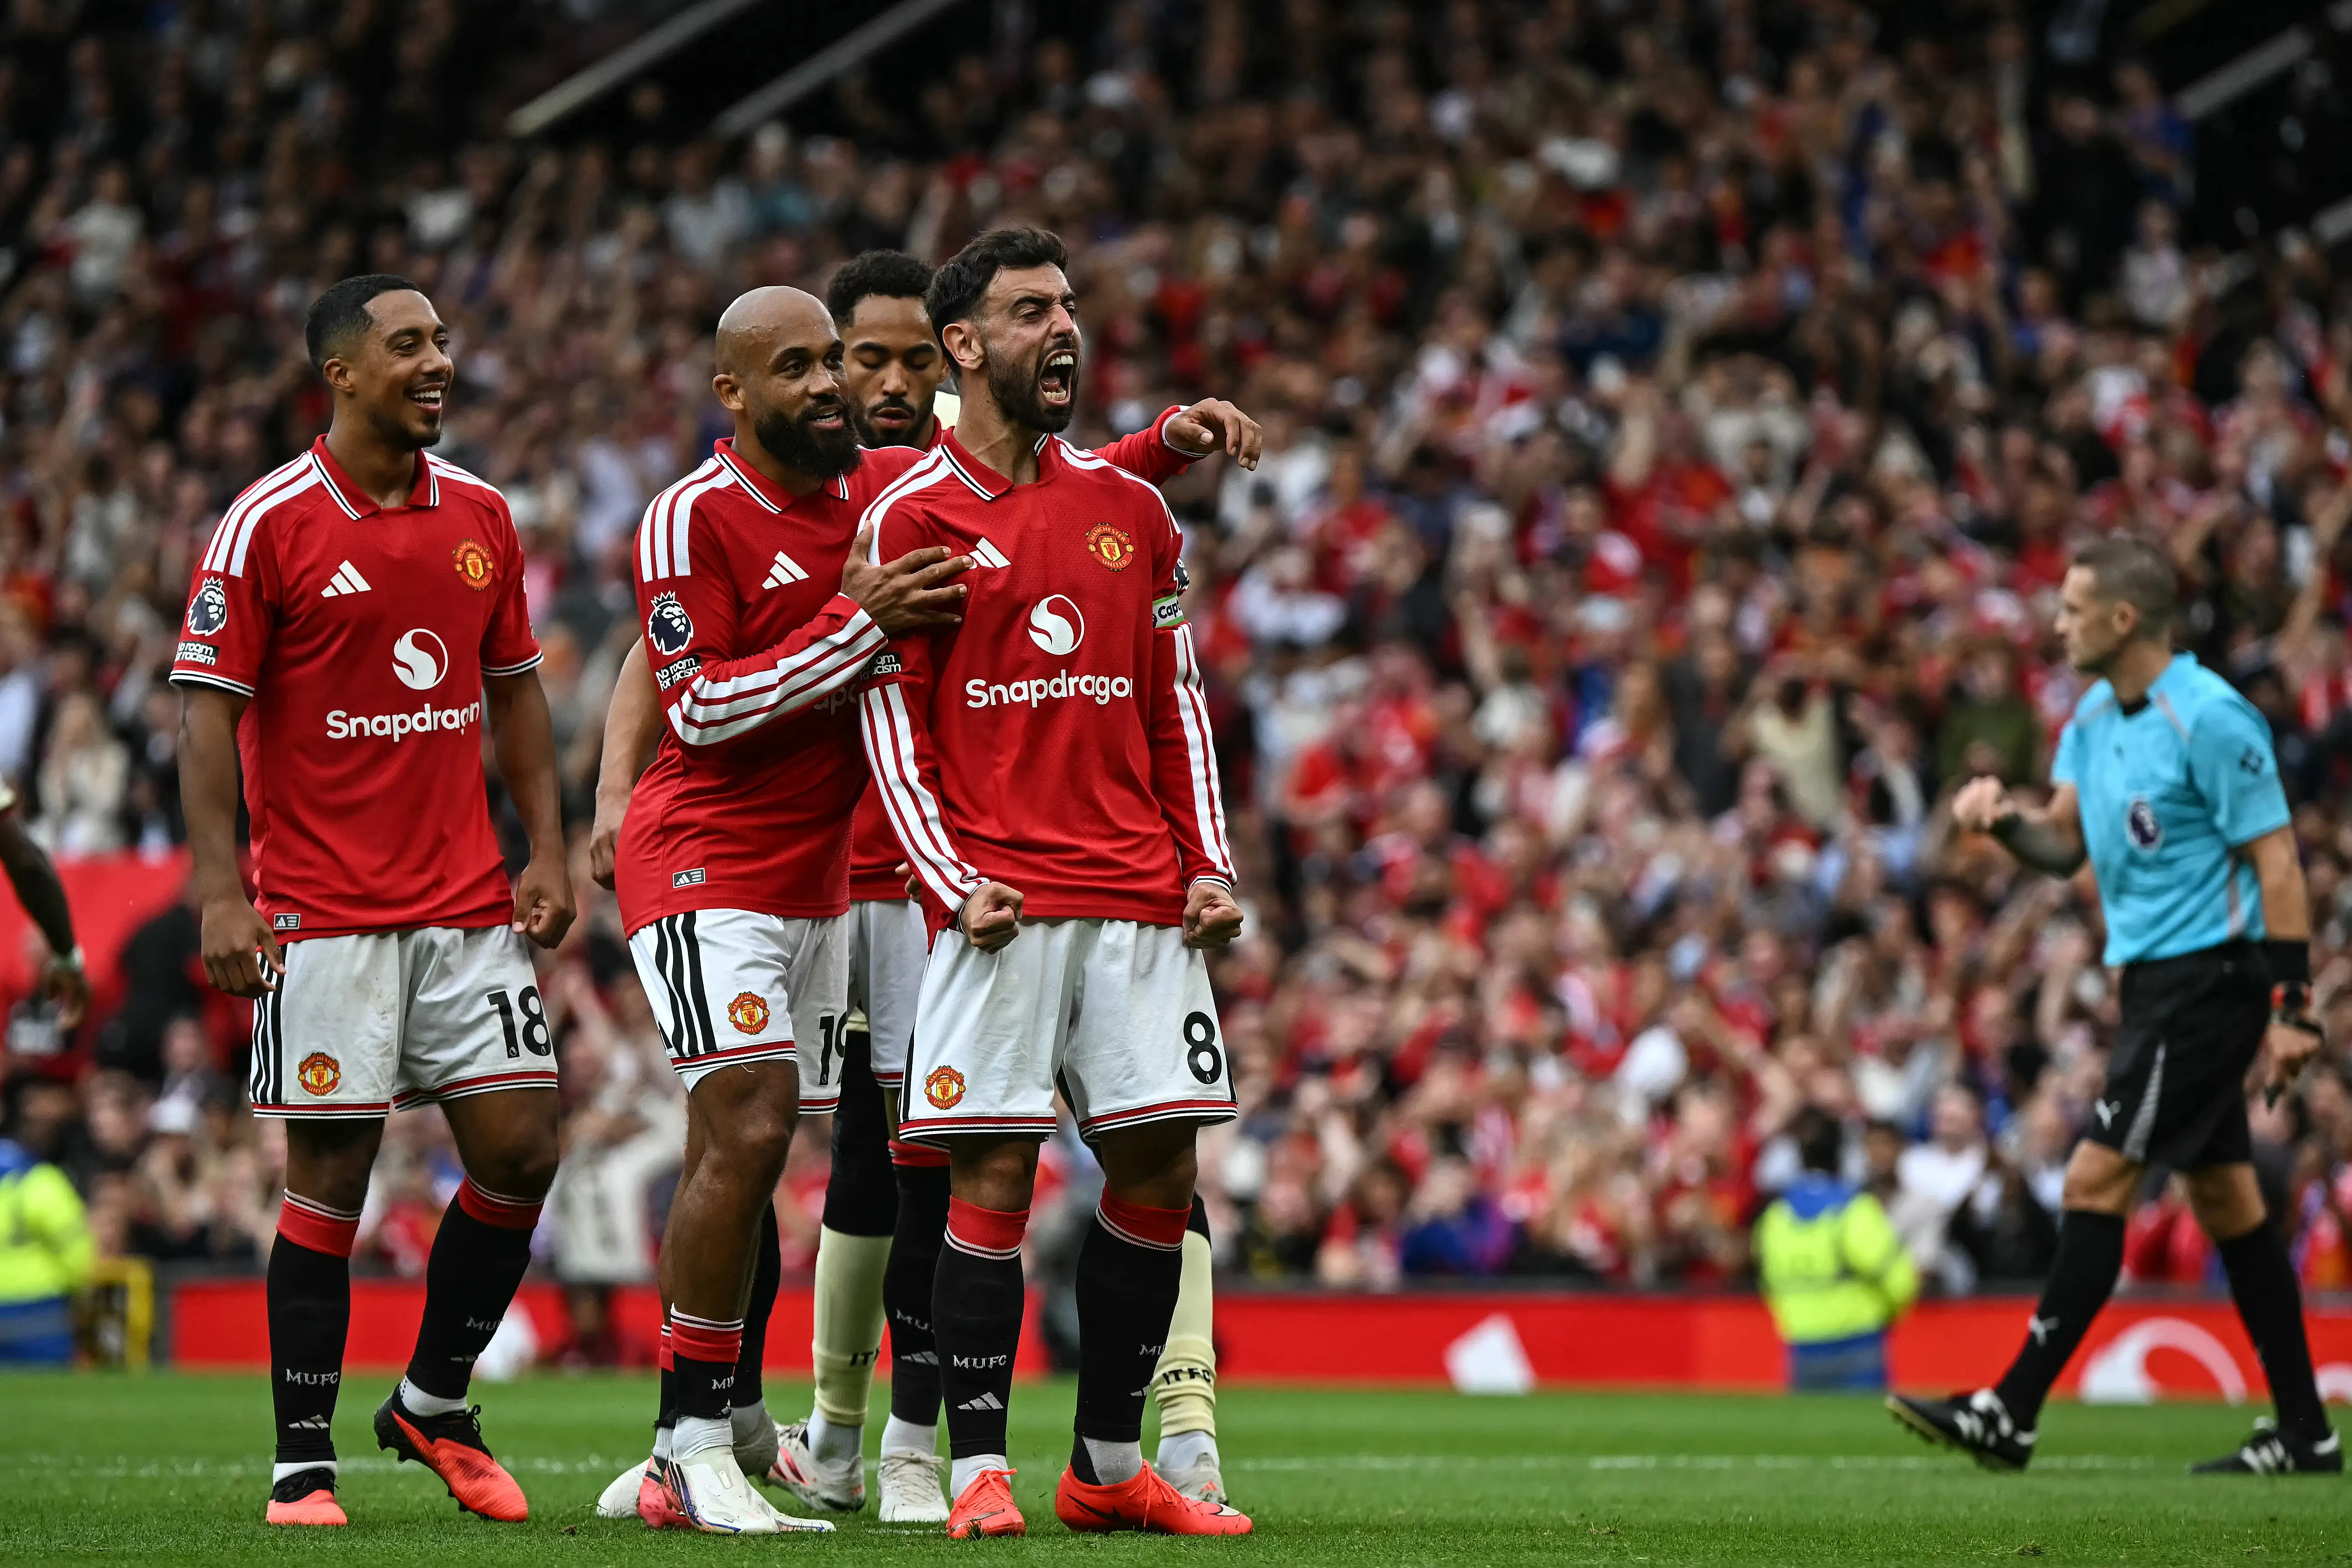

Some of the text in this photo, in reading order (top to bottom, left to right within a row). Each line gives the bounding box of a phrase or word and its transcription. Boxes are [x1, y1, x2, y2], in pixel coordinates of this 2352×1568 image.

[1090, 526, 1126, 542] MANCHESTER
[1103, 559, 1127, 568] UNITED
[184, 643, 213, 656] room
[655, 658, 696, 682] No room
[660, 677, 671, 692] for
[965, 669, 1133, 708] Snapdrago
[731, 995, 764, 1012] MANCHESTER
[487, 986, 552, 1059] 18
[742, 1023, 764, 1032] UNITED
[1183, 1011, 1222, 1085] 8
[929, 1069, 961, 1084] MANCHESTER
[933, 1099, 956, 1107] UNITED
[953, 1355, 1007, 1369] MUFC
[286, 1368, 339, 1387] MUFC
[1162, 1368, 1211, 1386] ITFC
